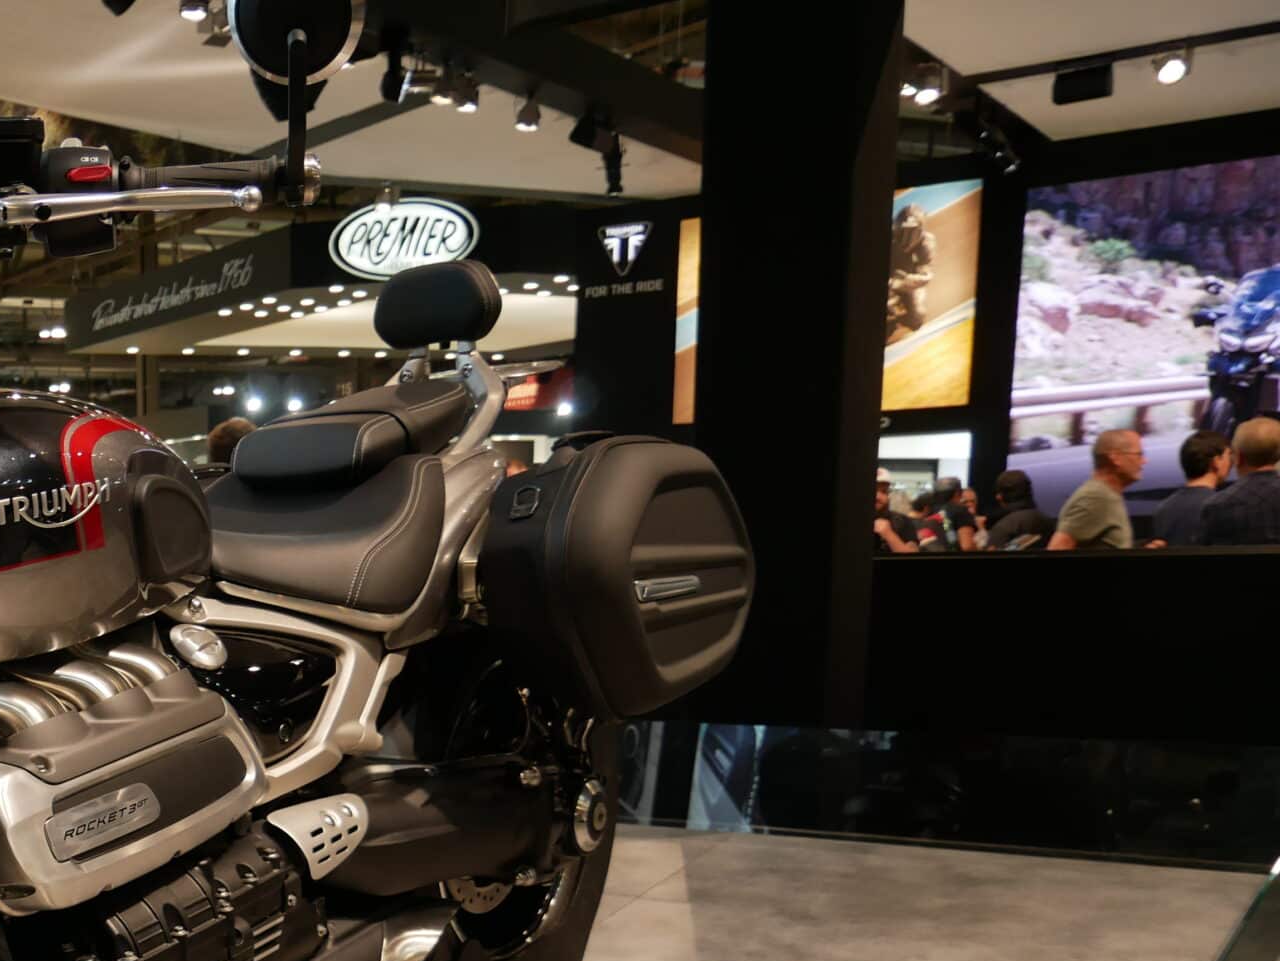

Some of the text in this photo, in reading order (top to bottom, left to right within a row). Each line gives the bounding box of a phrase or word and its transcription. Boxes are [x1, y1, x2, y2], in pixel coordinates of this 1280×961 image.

[347, 215, 469, 266] PREMIER
[584, 285, 608, 298] FOR
[611, 282, 633, 295] THE
